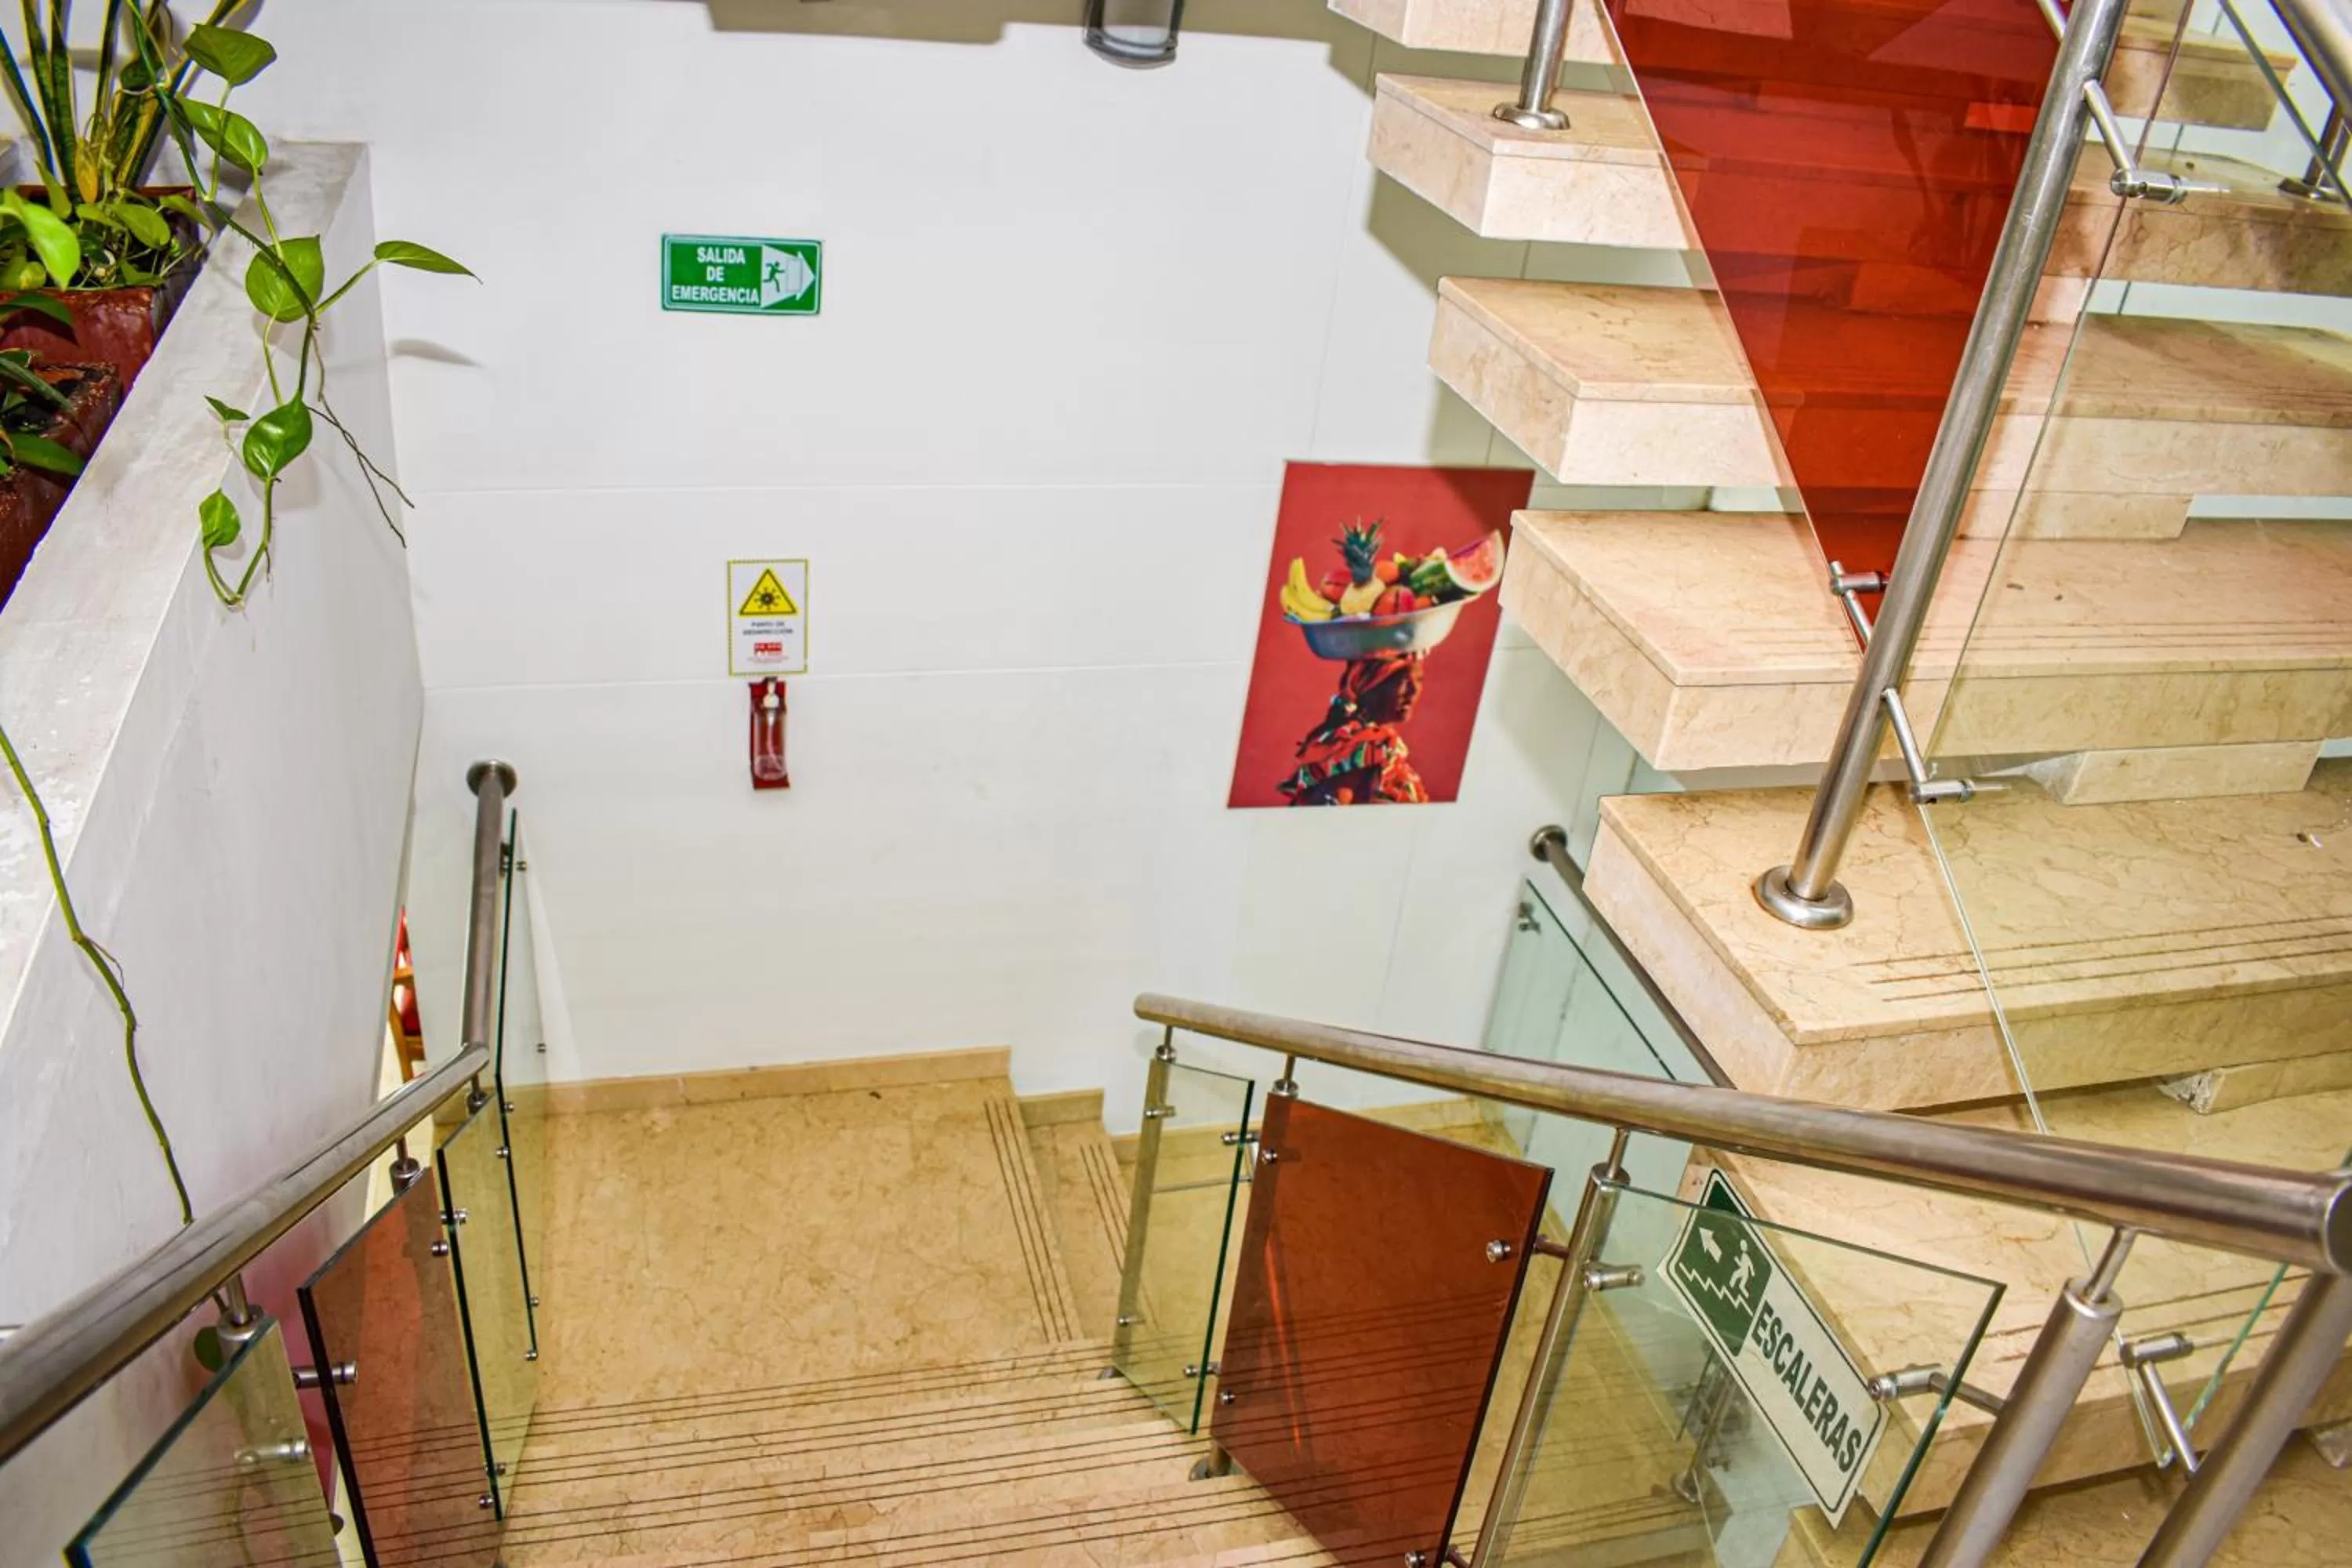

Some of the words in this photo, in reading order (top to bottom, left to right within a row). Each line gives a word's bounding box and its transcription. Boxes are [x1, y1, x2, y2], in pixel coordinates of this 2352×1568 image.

[697, 246, 746, 264] SALIDA
[706, 266, 724, 282] DE
[672, 285, 759, 303] EMERGENCIA
[1751, 1300, 1862, 1472] ESCALERAS
